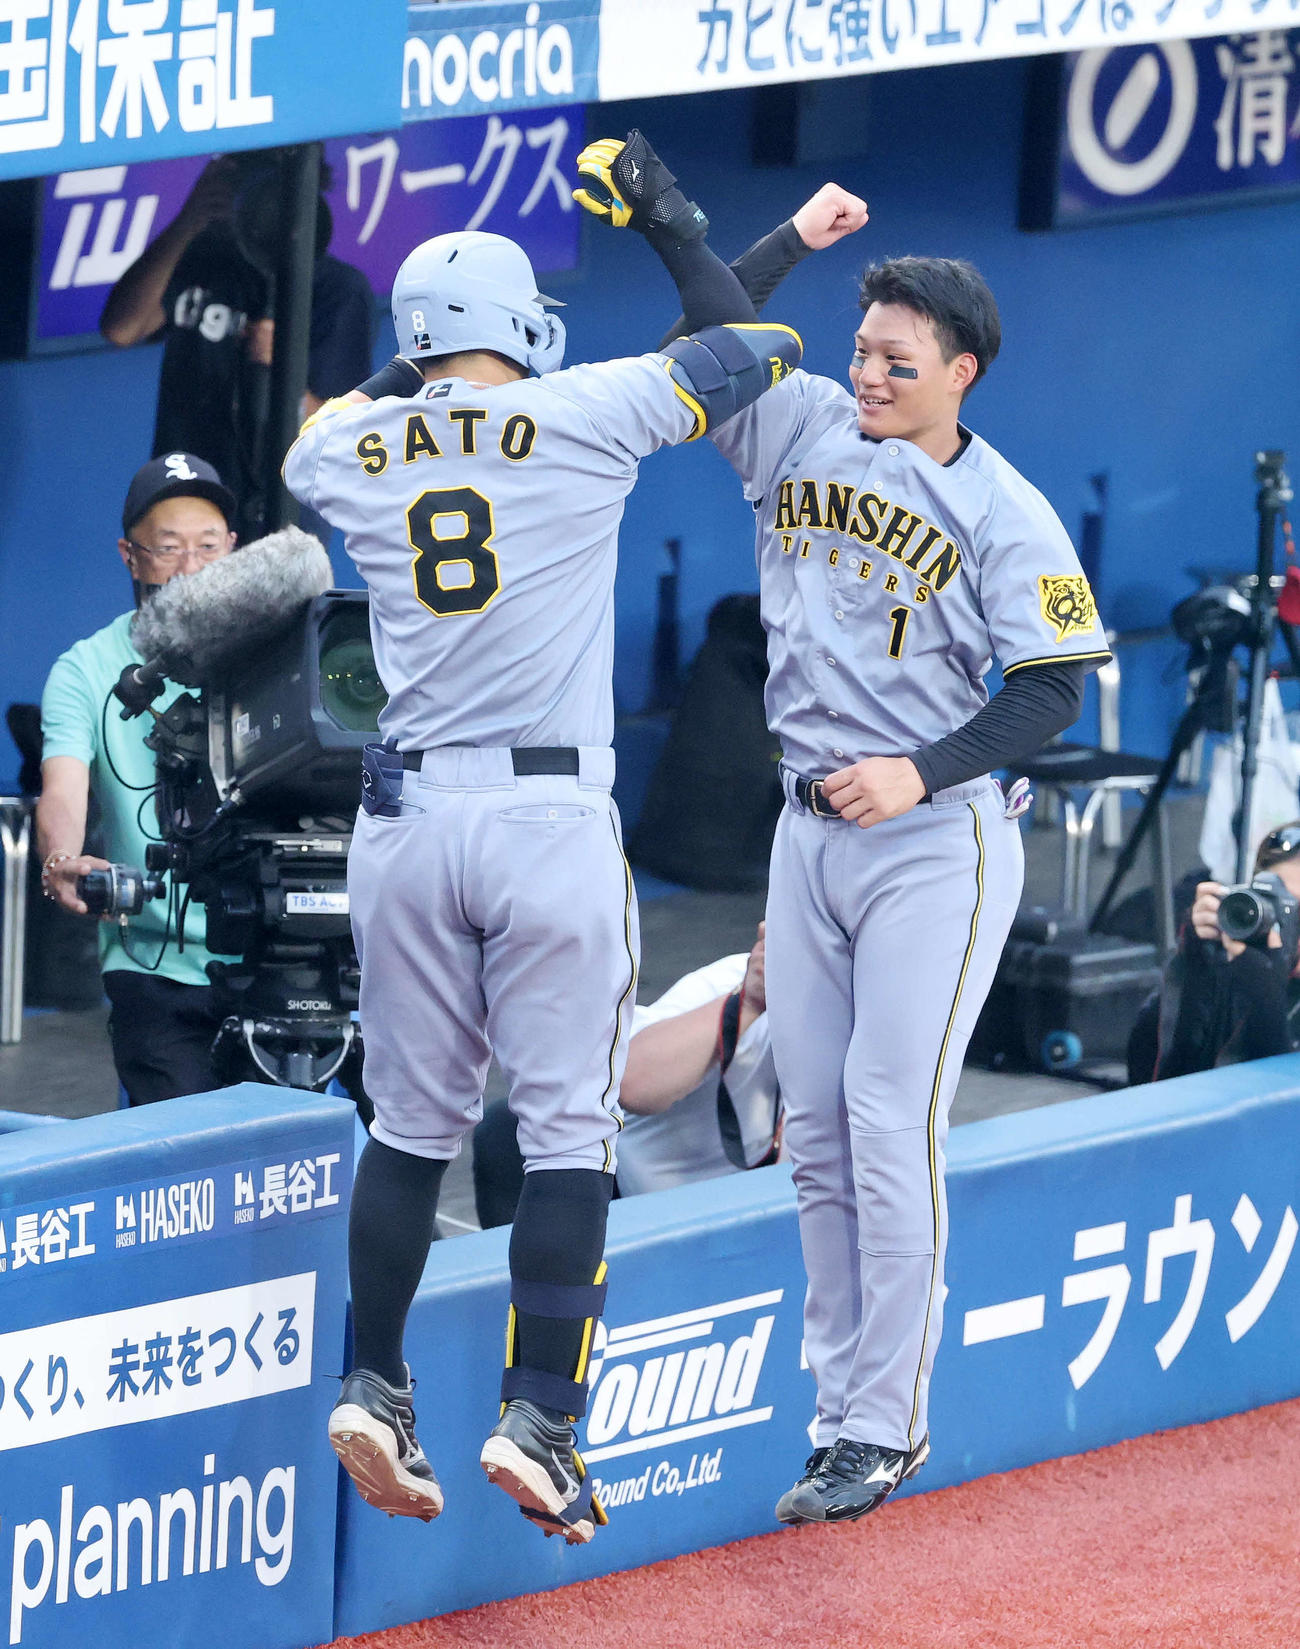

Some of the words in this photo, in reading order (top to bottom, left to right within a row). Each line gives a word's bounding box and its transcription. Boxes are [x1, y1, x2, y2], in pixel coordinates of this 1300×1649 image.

[401, 2, 574, 109] nocria
[1214, 32, 1300, 170] 清
[412, 310, 426, 332] 8
[356, 408, 538, 476] SATO
[406, 485, 502, 618] 8
[774, 479, 962, 593] HANSHIN
[781, 534, 931, 604] TIGERS
[887, 606, 912, 662] 1
[292, 895, 316, 907] TBS
[141, 1178, 215, 1244] HASEKO
[259, 1153, 341, 1220] 長谷工
[11, 1201, 96, 1270] 長谷工
[0, 1307, 300, 1421] くり、未来をつくる
[9, 1454, 296, 1645] planning
